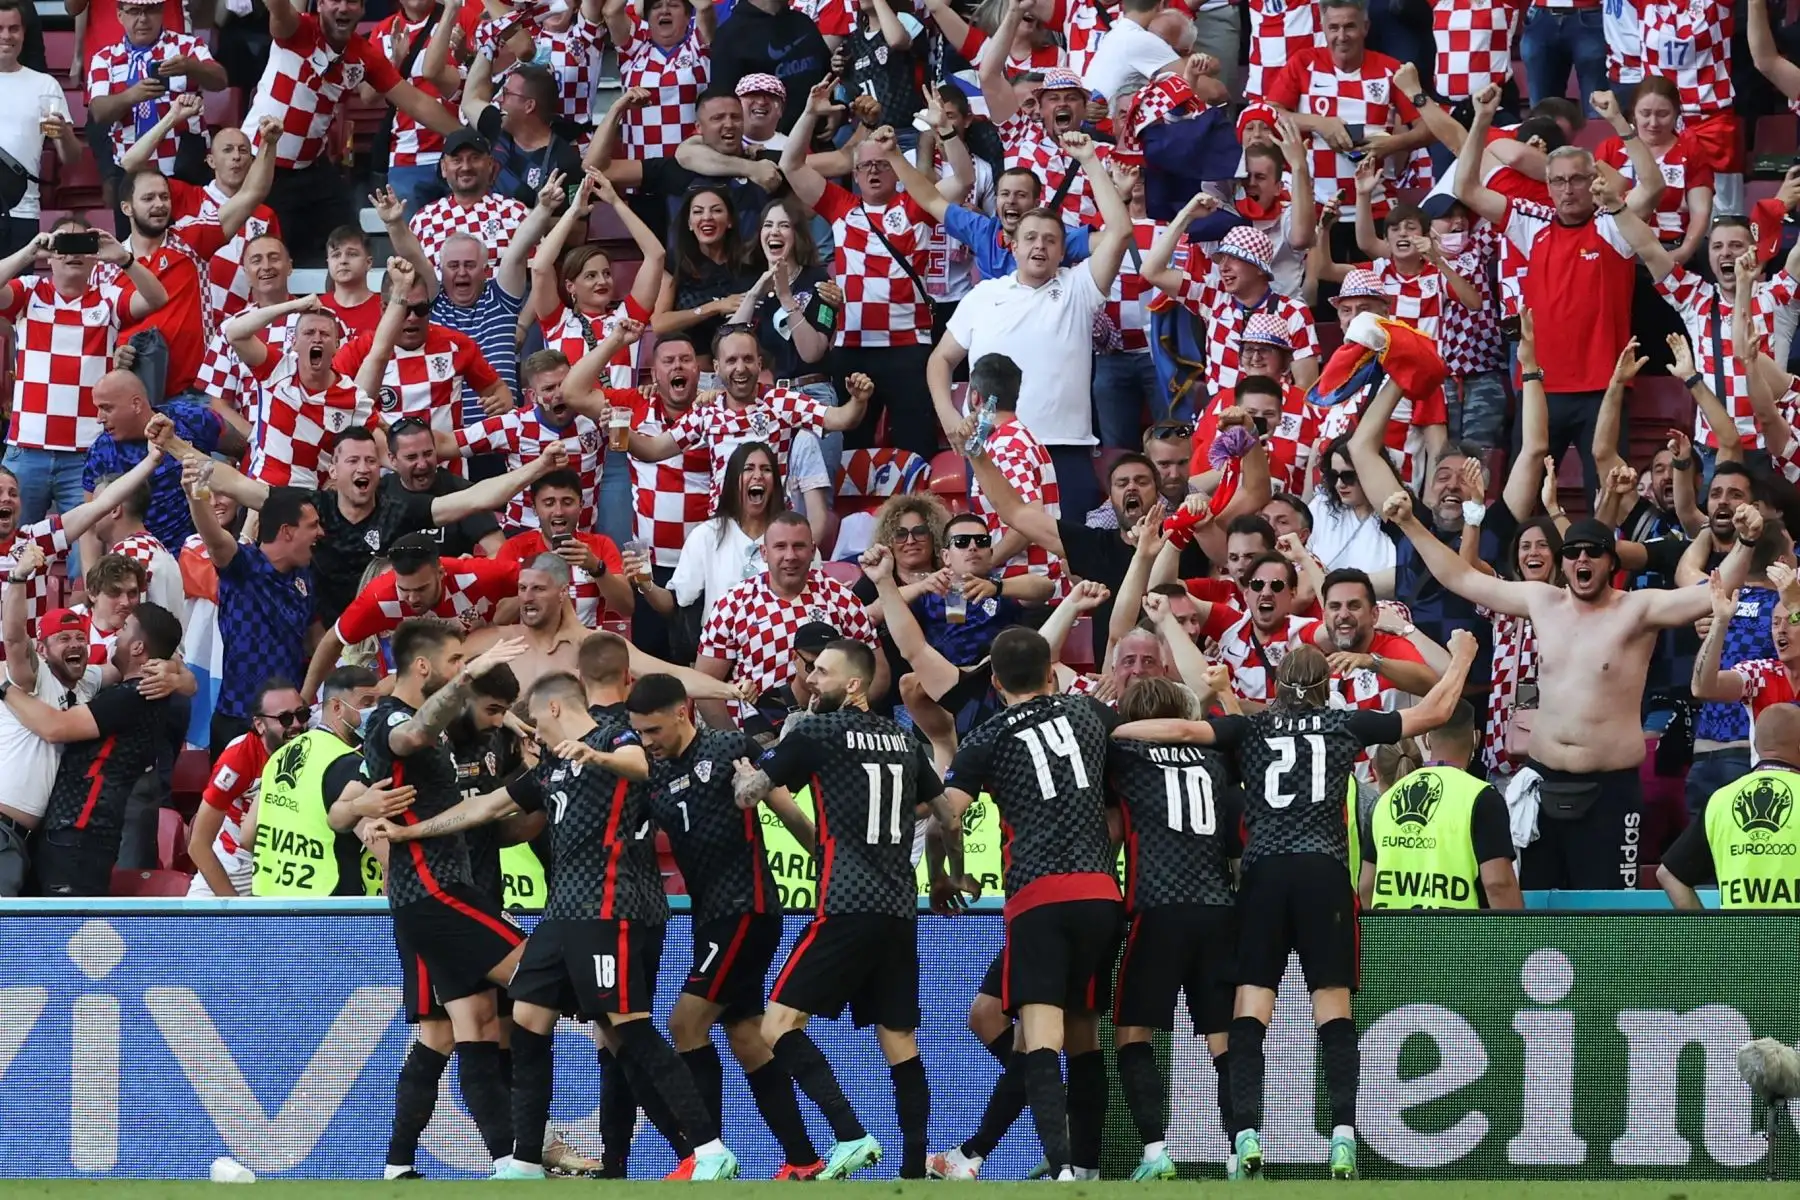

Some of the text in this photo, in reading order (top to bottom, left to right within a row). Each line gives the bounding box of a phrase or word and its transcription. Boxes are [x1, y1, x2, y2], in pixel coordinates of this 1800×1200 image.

[1664, 41, 1690, 66] 17
[1013, 715, 1090, 801] 14
[1263, 734, 1327, 809] 21
[861, 762, 904, 845] 11
[1155, 763, 1217, 836] 10
[1619, 811, 1642, 891] didas
[1730, 843, 1796, 857] EURO2020
[592, 954, 616, 989] 18
